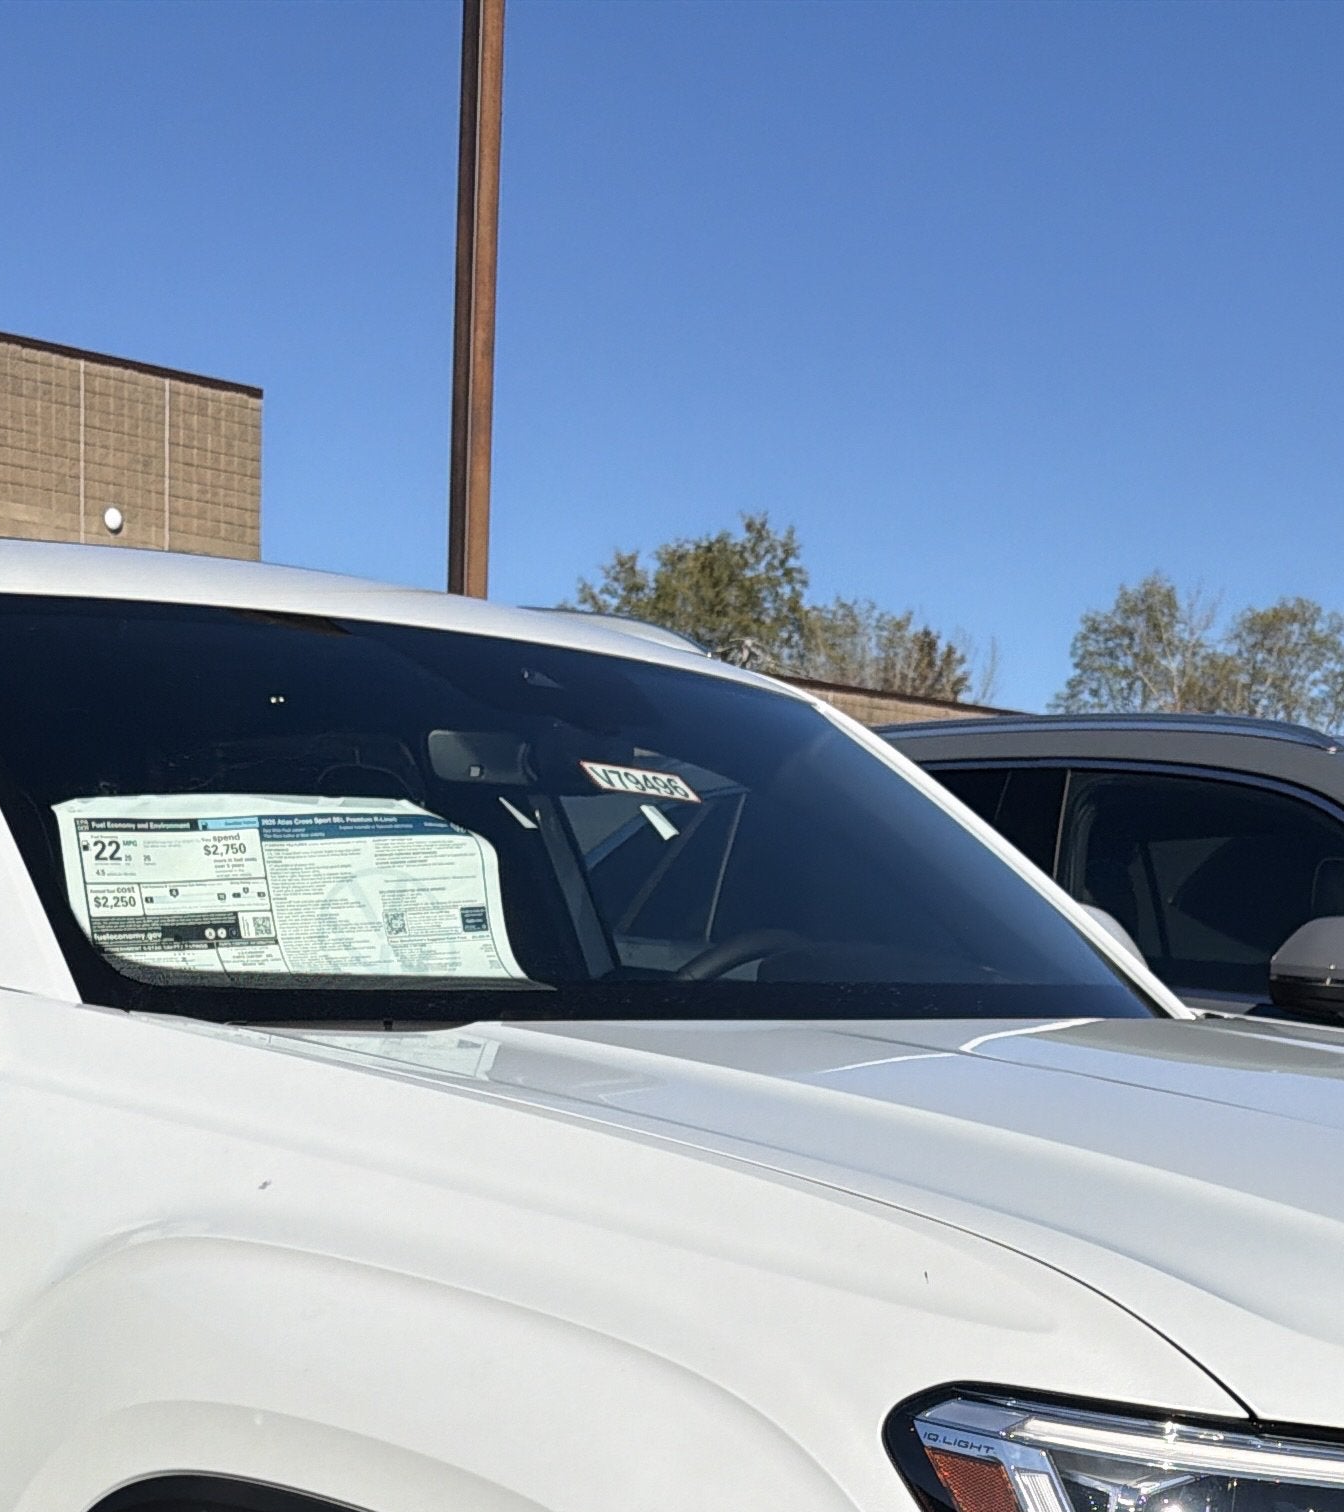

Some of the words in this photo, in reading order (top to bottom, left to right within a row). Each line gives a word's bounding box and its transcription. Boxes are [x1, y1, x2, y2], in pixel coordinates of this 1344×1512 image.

[589, 766, 690, 799] V79496
[107, 821, 136, 830] Economy
[149, 821, 191, 829] Environment
[277, 818, 293, 826] Atlas
[294, 817, 313, 826] Cross
[314, 816, 332, 826] Sport
[212, 832, 241, 843] spend
[93, 840, 122, 861] 22
[203, 843, 247, 857] $2,750
[116, 886, 136, 894] cost
[94, 896, 137, 909] $2,250
[94, 931, 162, 943] fueleconomy.gov
[923, 1432, 995, 1453] IQ.LIGHT
